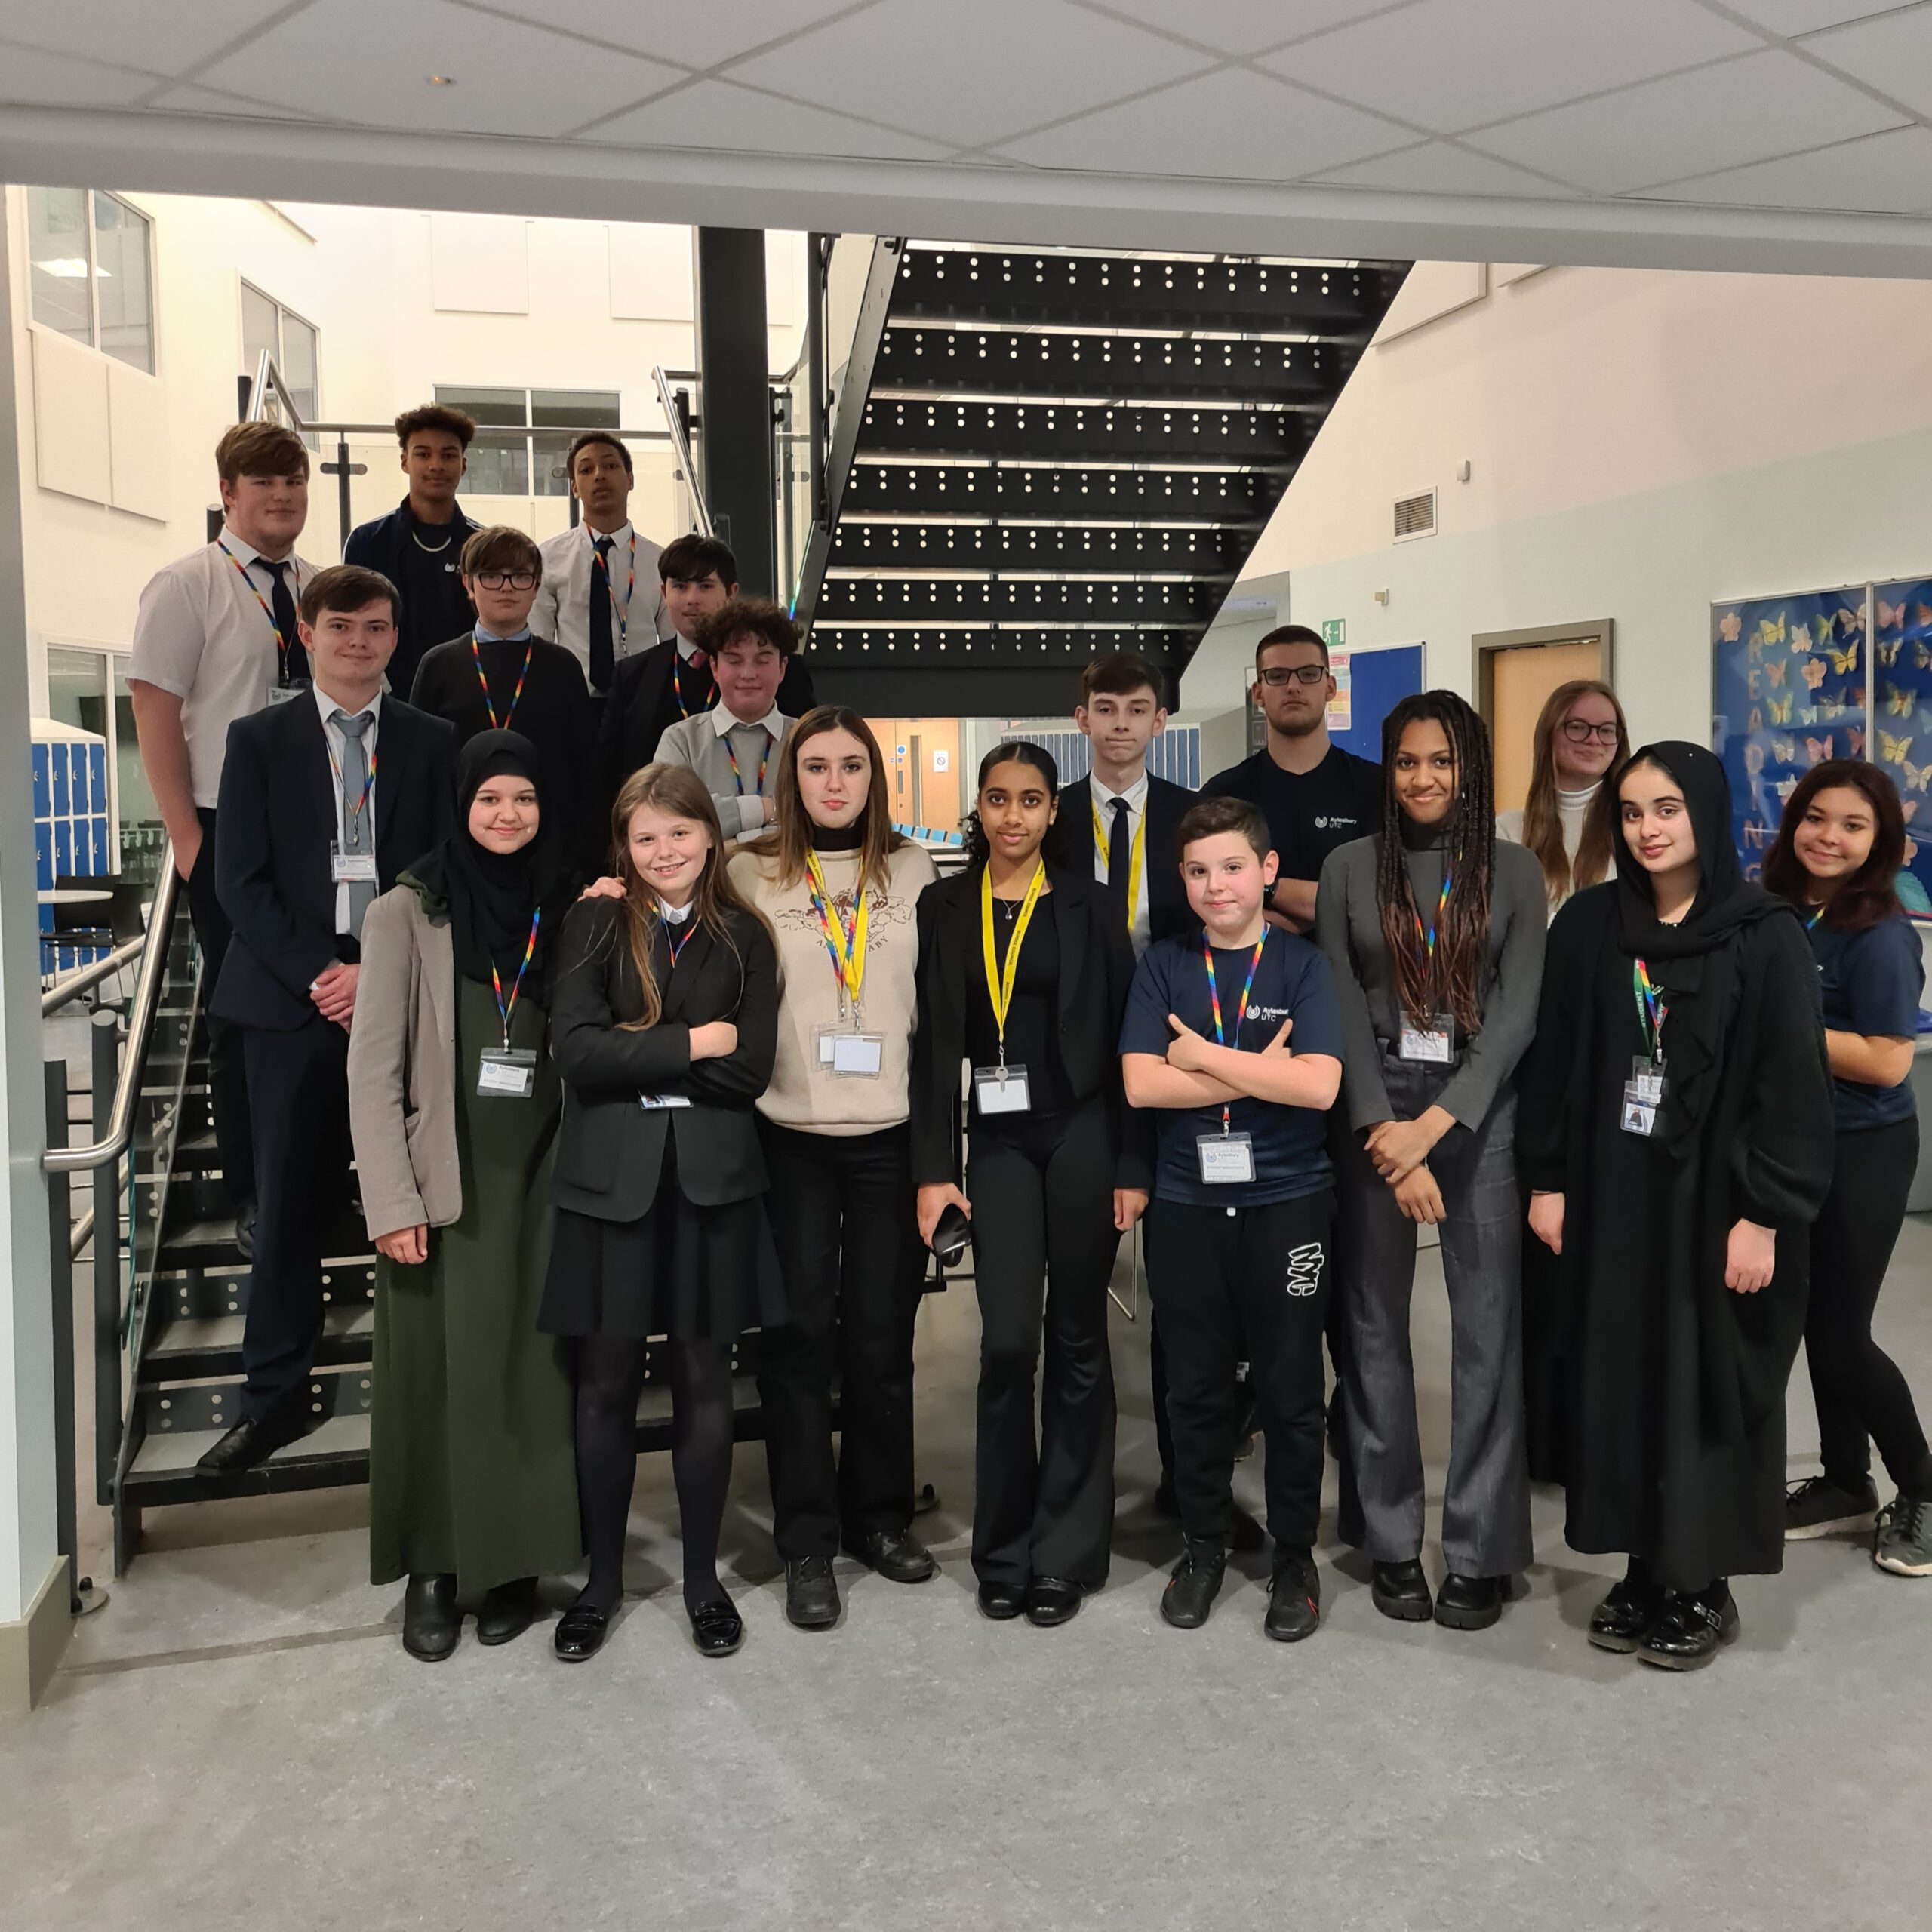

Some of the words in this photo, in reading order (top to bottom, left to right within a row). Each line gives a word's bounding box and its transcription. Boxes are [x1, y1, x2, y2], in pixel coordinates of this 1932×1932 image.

[867, 935, 888, 952] ABY
[1261, 1014, 1277, 1022] UTC
[1635, 991, 1646, 1027] STUDENT
[1287, 1242, 1325, 1296] NYC
